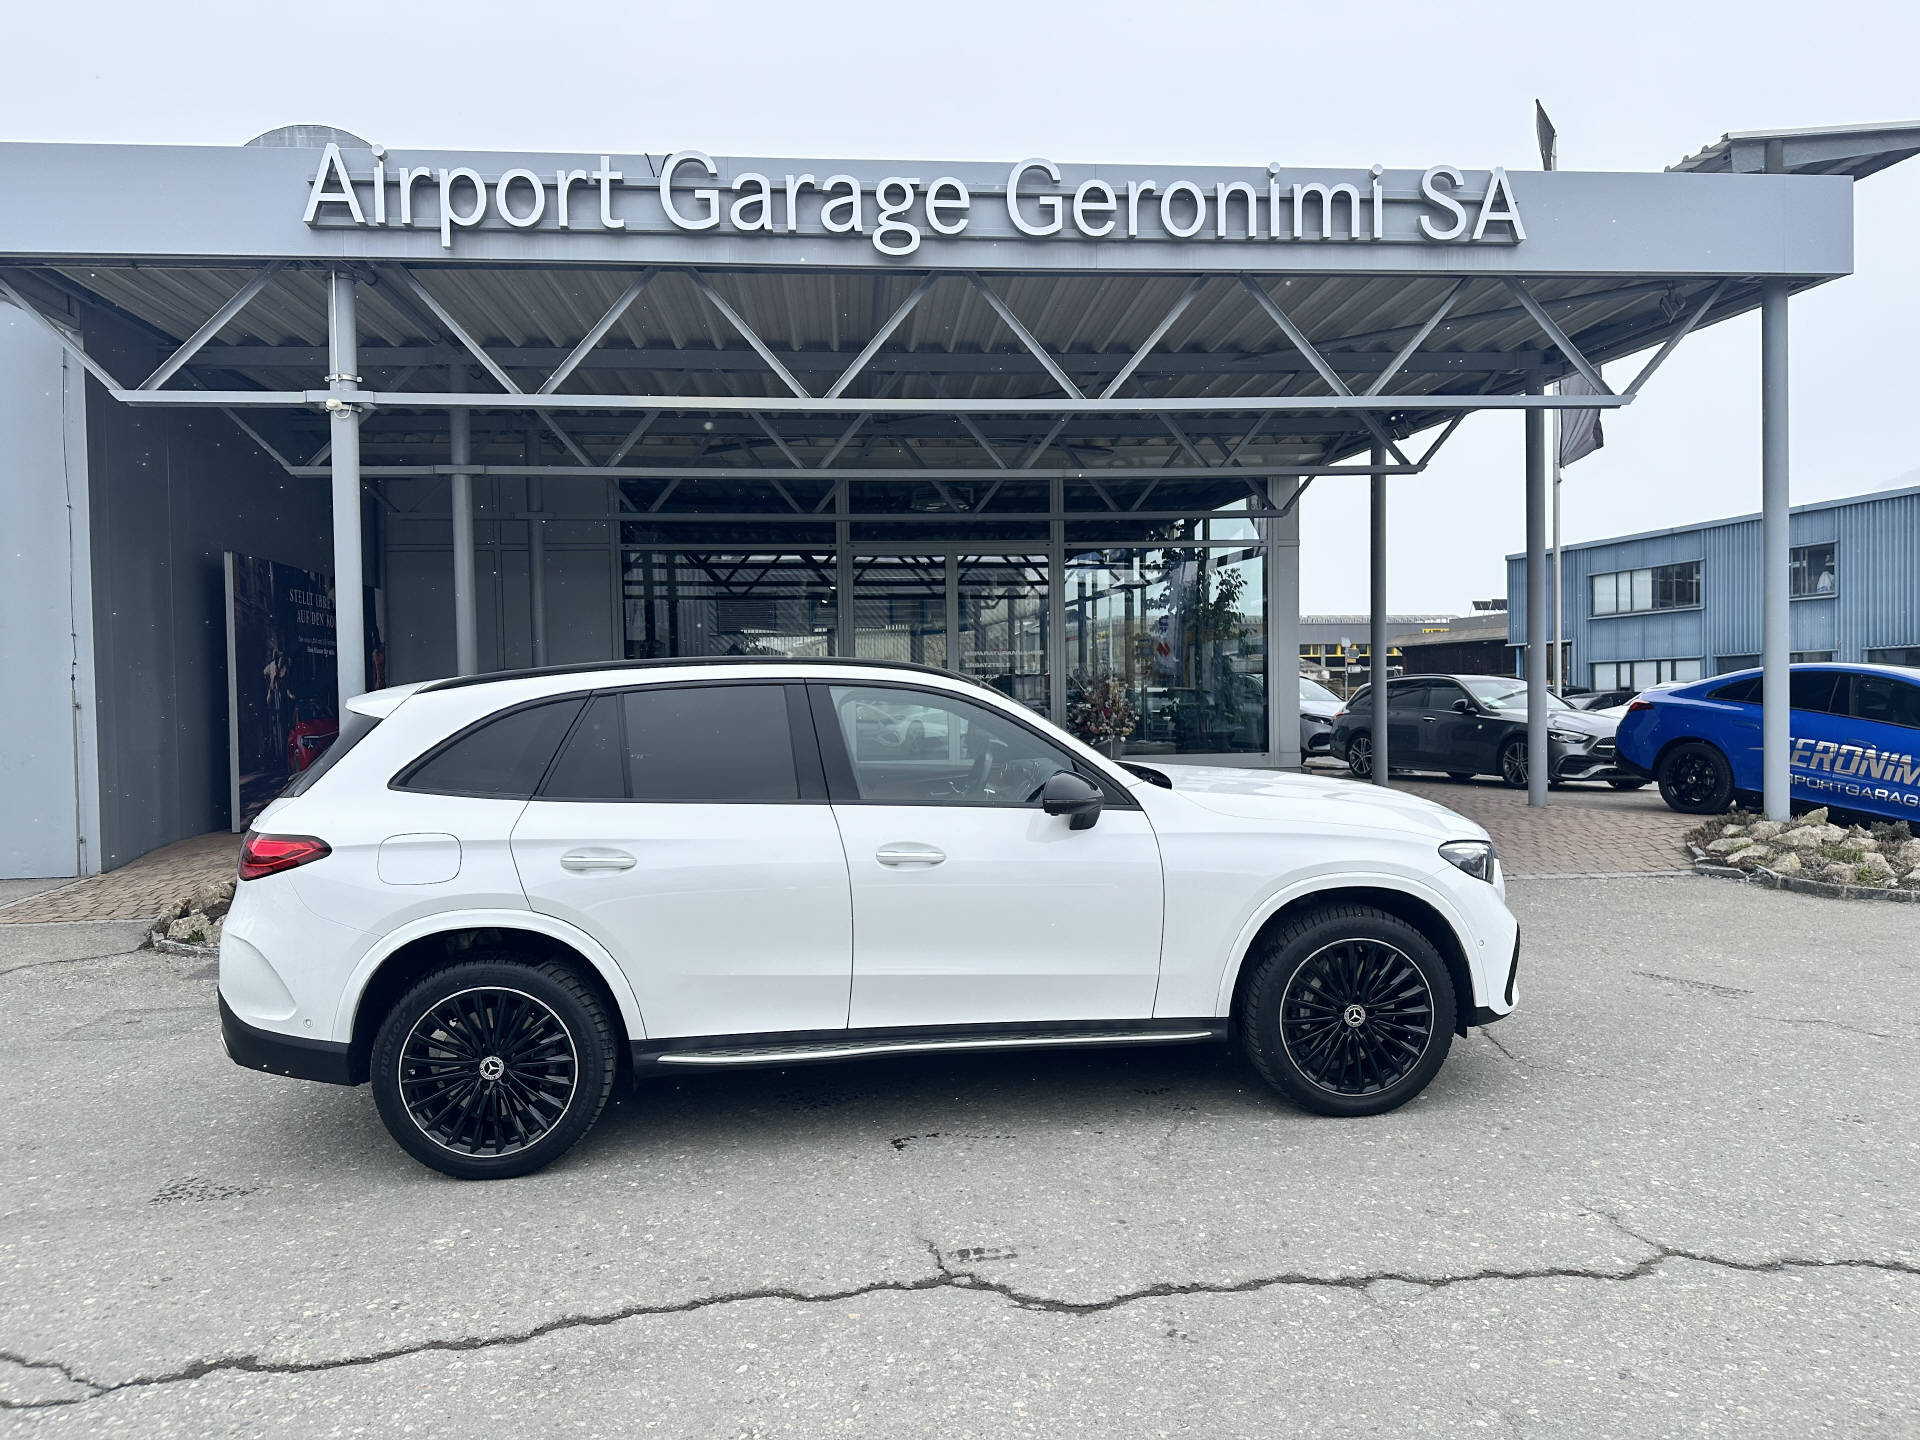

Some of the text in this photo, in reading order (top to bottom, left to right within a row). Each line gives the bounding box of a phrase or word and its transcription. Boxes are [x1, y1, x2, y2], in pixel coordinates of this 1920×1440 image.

[302, 142, 1528, 256] Airport Garage Geronimi SA
[311, 611, 324, 626] DEN
[1790, 737, 1920, 787] ERONIM
